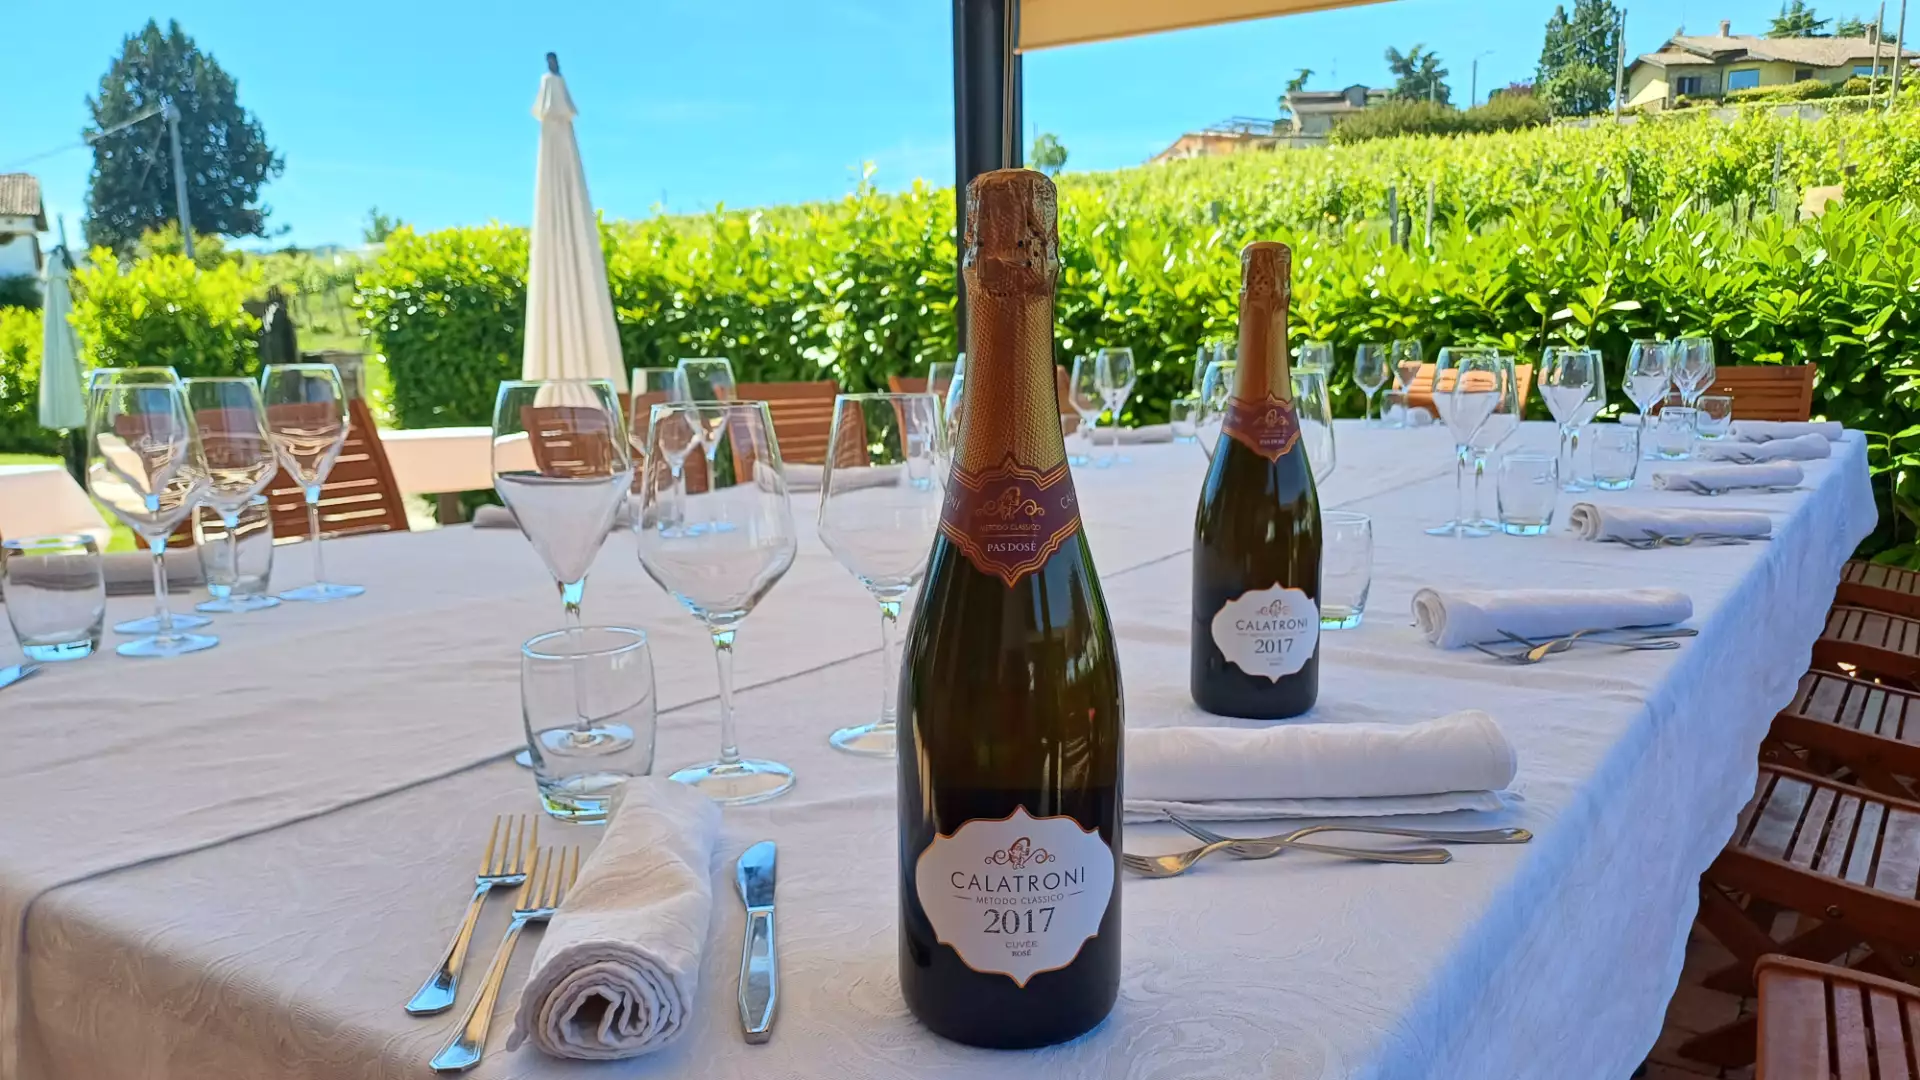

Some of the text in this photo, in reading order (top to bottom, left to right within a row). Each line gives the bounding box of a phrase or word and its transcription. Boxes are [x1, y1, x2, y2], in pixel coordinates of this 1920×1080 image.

[987, 540, 1037, 552] PAS DOSÉ
[1235, 618, 1308, 632] CALATRONI
[1254, 638, 1294, 654] 2017
[950, 866, 1085, 893] CALATRONI
[976, 893, 1064, 906] METODO CLASSICO
[983, 906, 1056, 935] 2017
[1005, 940, 1039, 949] CUVÉE
[1011, 949, 1032, 958] ROSÉ
